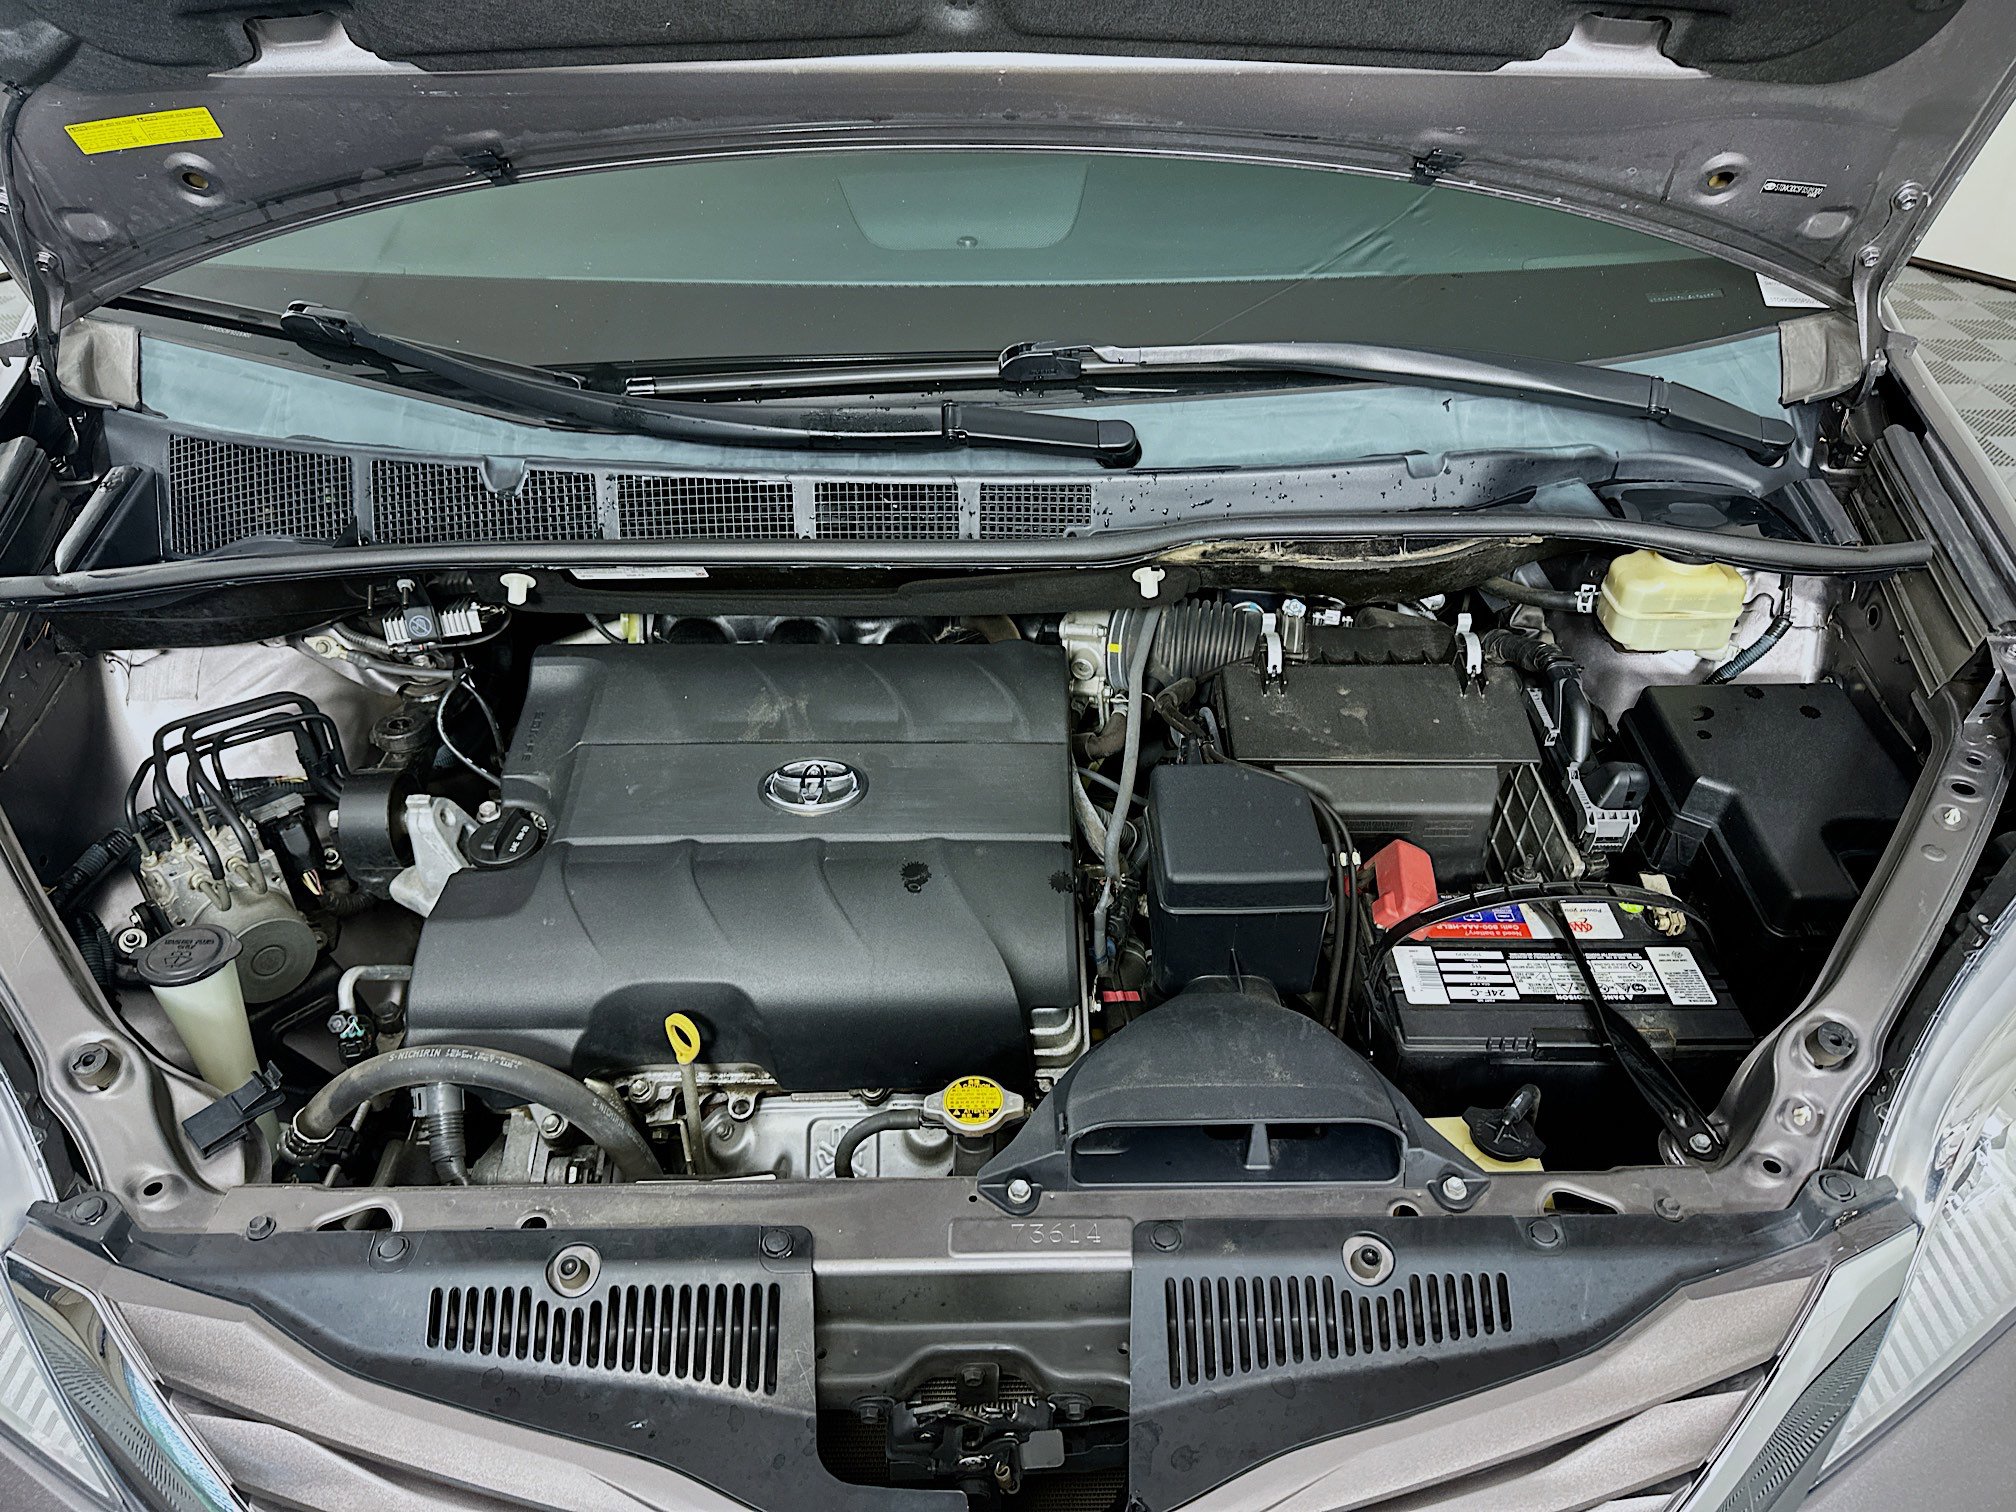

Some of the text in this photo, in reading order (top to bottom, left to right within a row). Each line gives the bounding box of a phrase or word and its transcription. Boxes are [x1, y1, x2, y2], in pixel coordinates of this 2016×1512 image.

[509, 841, 521, 853] SAE
[1464, 929, 1494, 937] battery?
[1470, 988, 1506, 997] 24F-C
[1011, 1223, 1101, 1245] 73614
